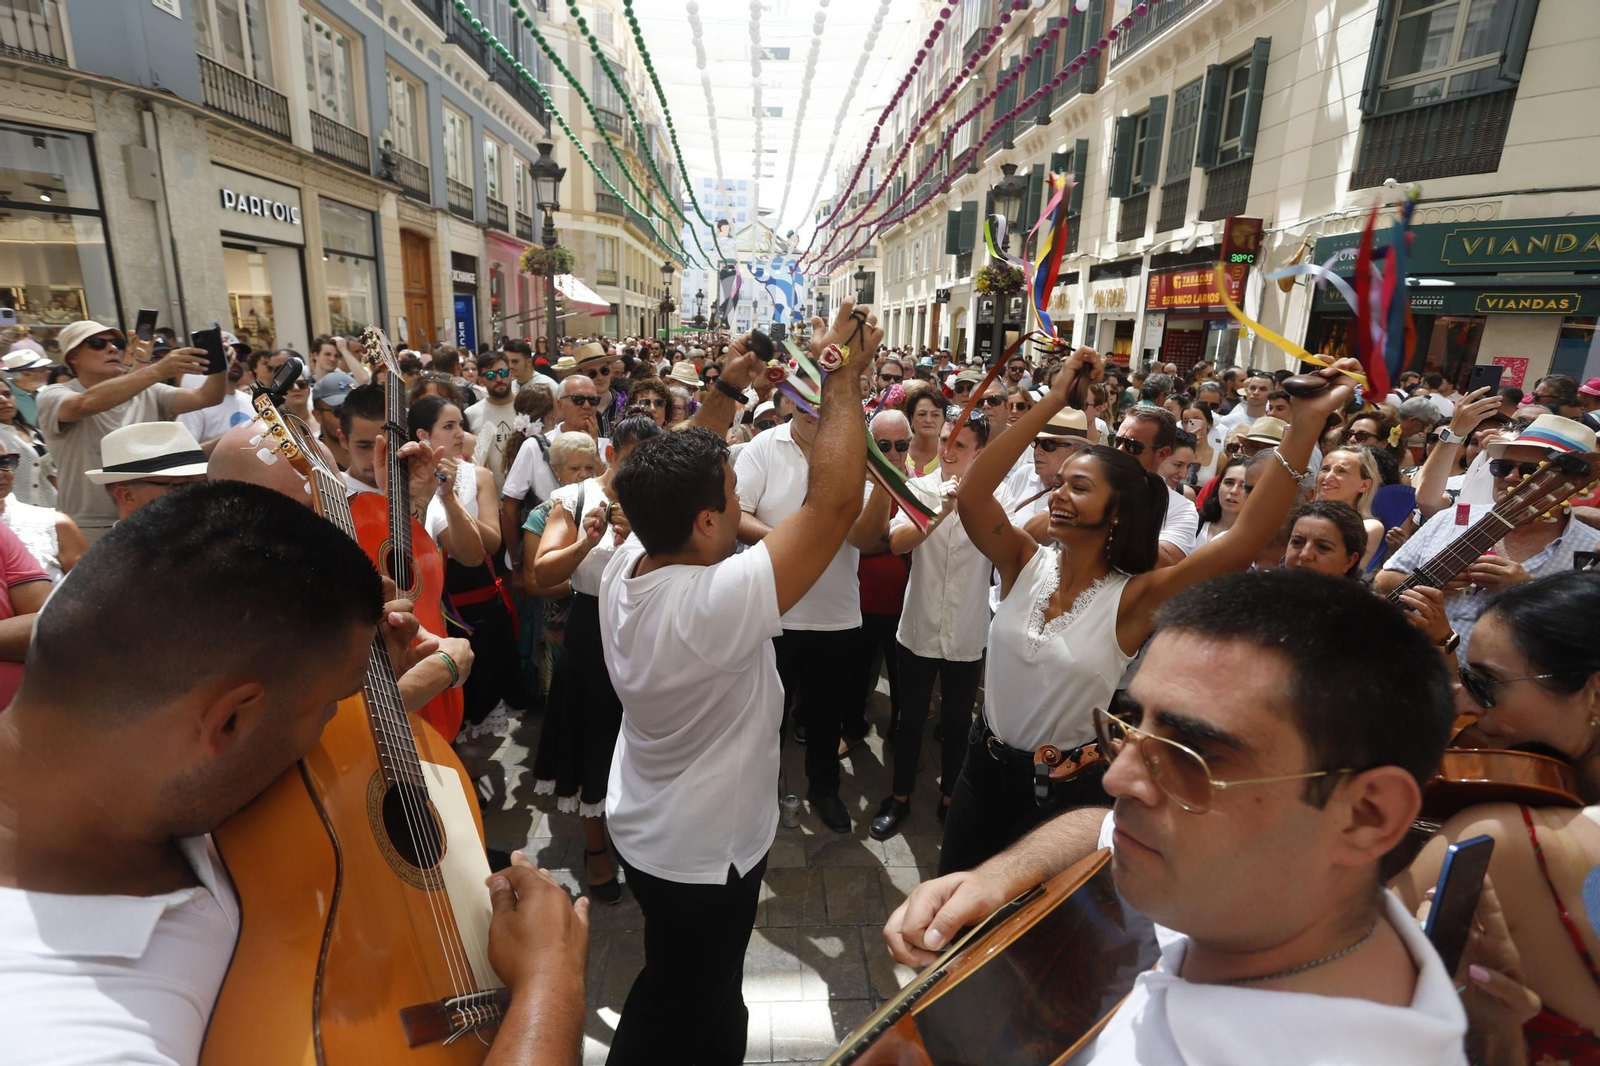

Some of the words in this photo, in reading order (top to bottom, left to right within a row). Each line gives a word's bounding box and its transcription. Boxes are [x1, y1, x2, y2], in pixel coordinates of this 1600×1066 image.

[221, 188, 300, 225] PARFOIS
[1462, 231, 1600, 257] VIANDA
[1182, 273, 1214, 284] TABACOS
[1162, 294, 1192, 305] ESTANCO
[1193, 292, 1220, 304] LARIOS
[1486, 298, 1570, 310] VIANDAS
